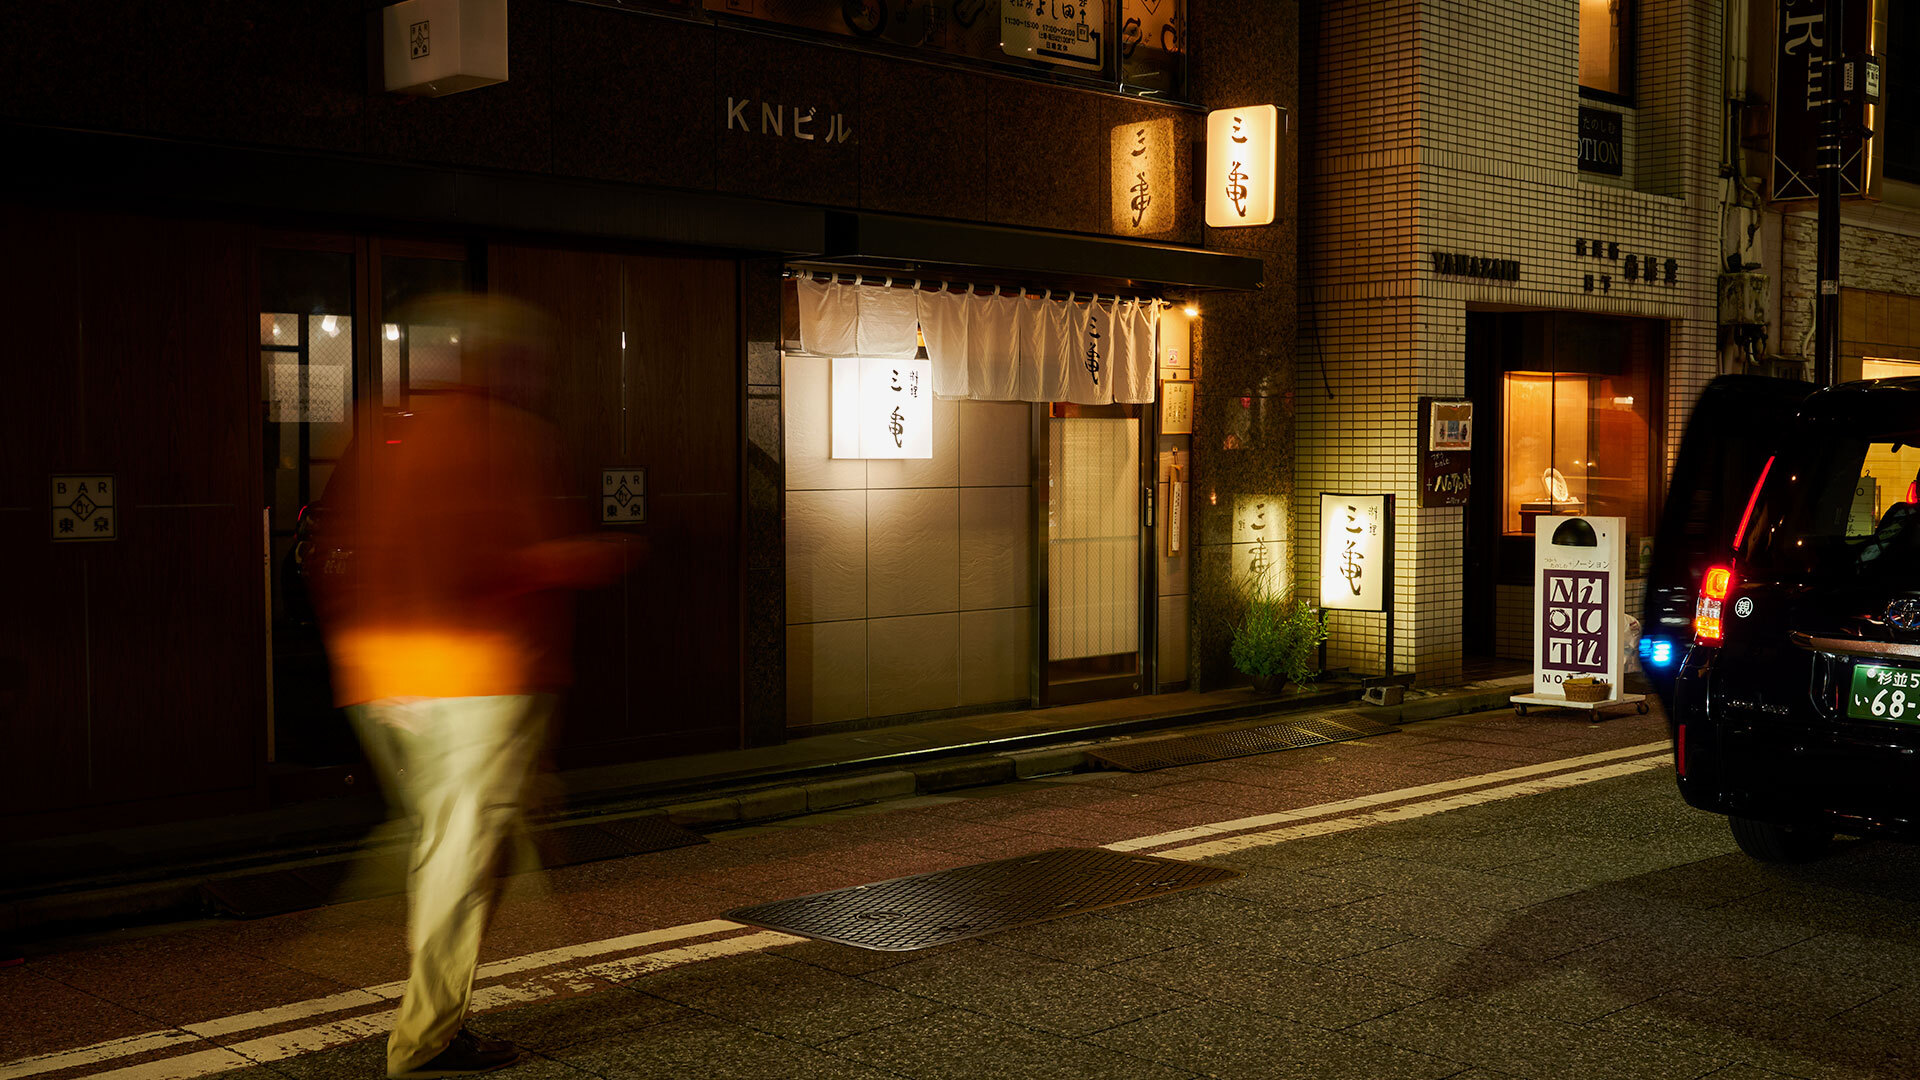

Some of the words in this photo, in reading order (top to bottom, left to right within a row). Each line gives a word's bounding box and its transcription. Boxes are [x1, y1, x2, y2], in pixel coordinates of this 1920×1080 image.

[607, 475, 640, 485] BAR
[57, 482, 107, 494] BAR
[1855, 693, 1869, 707] い
